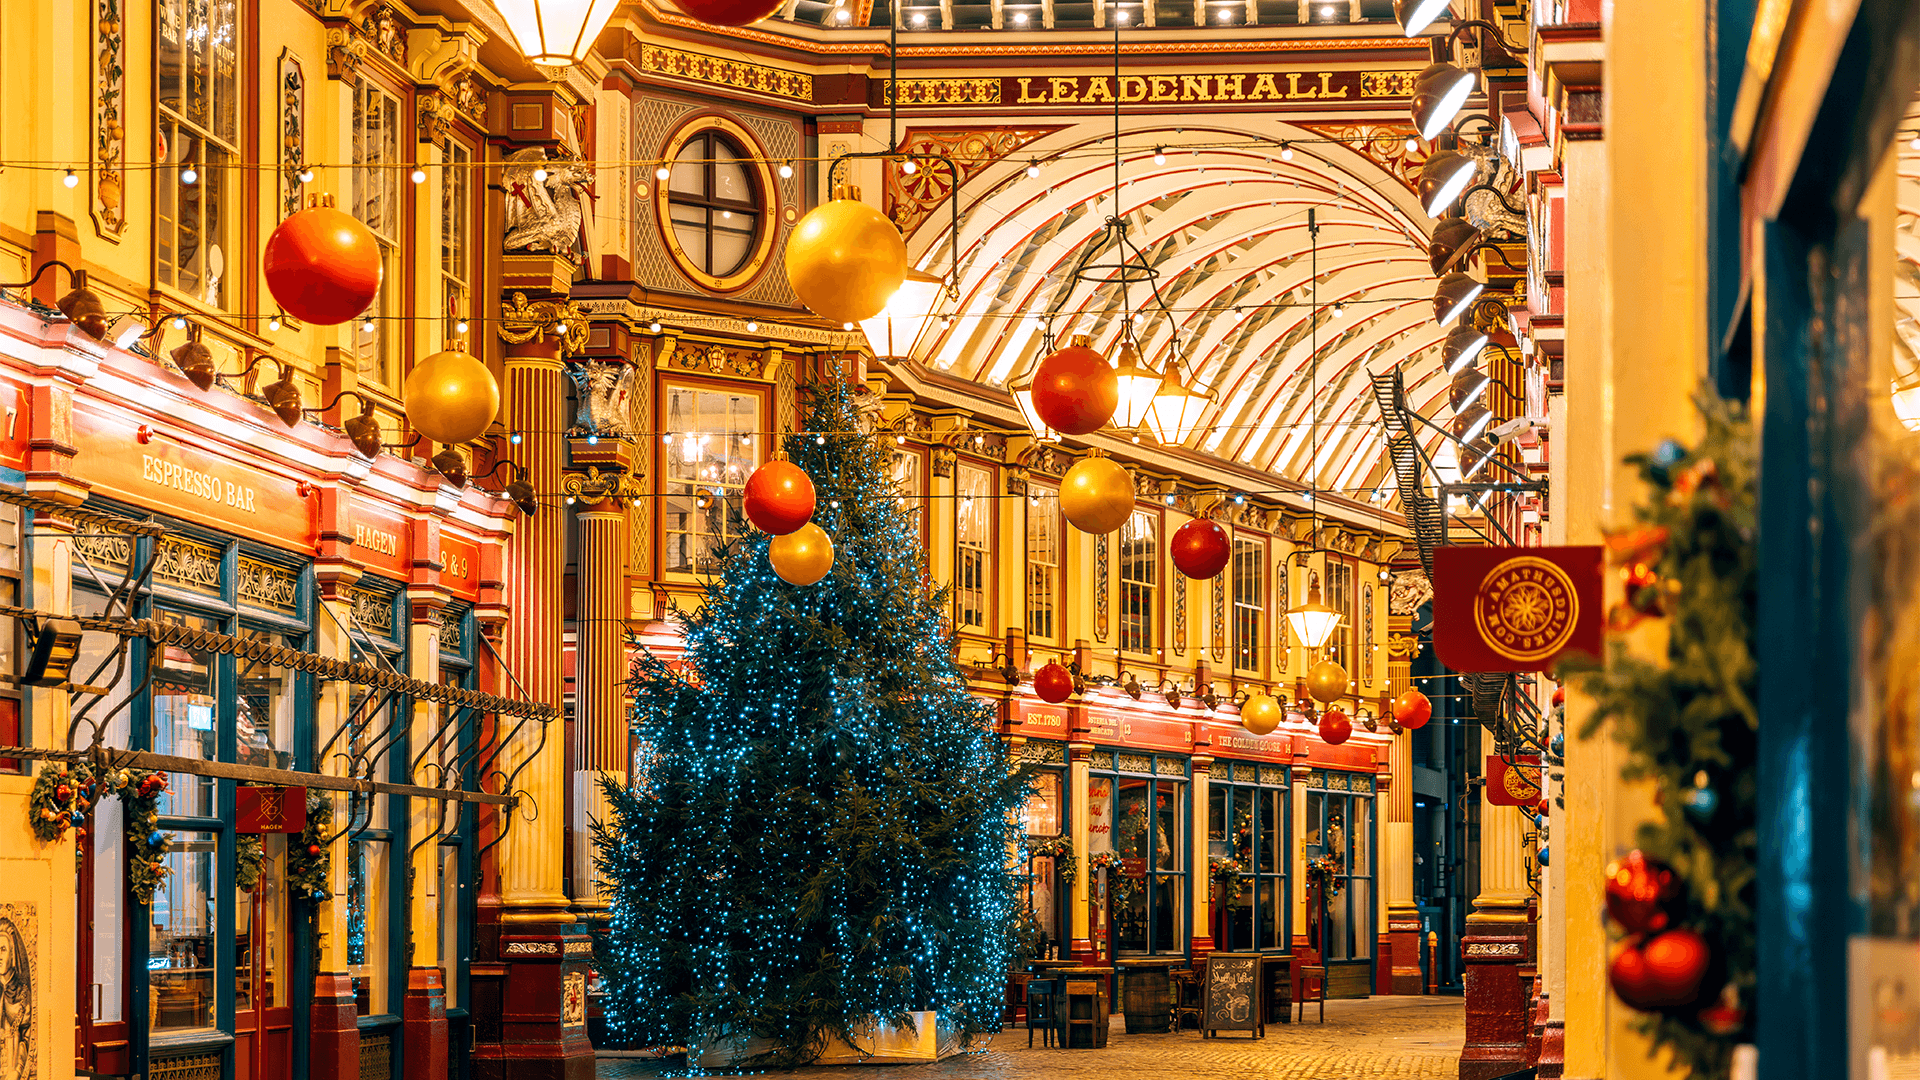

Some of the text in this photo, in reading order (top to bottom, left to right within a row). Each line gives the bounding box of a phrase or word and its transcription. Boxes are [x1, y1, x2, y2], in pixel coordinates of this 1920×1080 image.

[162, 23, 178, 45] BAR
[1017, 73, 1348, 103] LEADENHALL
[6, 406, 17, 440] 7
[143, 454, 256, 514] ESPRESSO BAR
[356, 524, 397, 557] HAGEN
[440, 550, 469, 579] 8 & 9
[1027, 712, 1061, 727] EST.1780
[1218, 736, 1232, 747] THE
